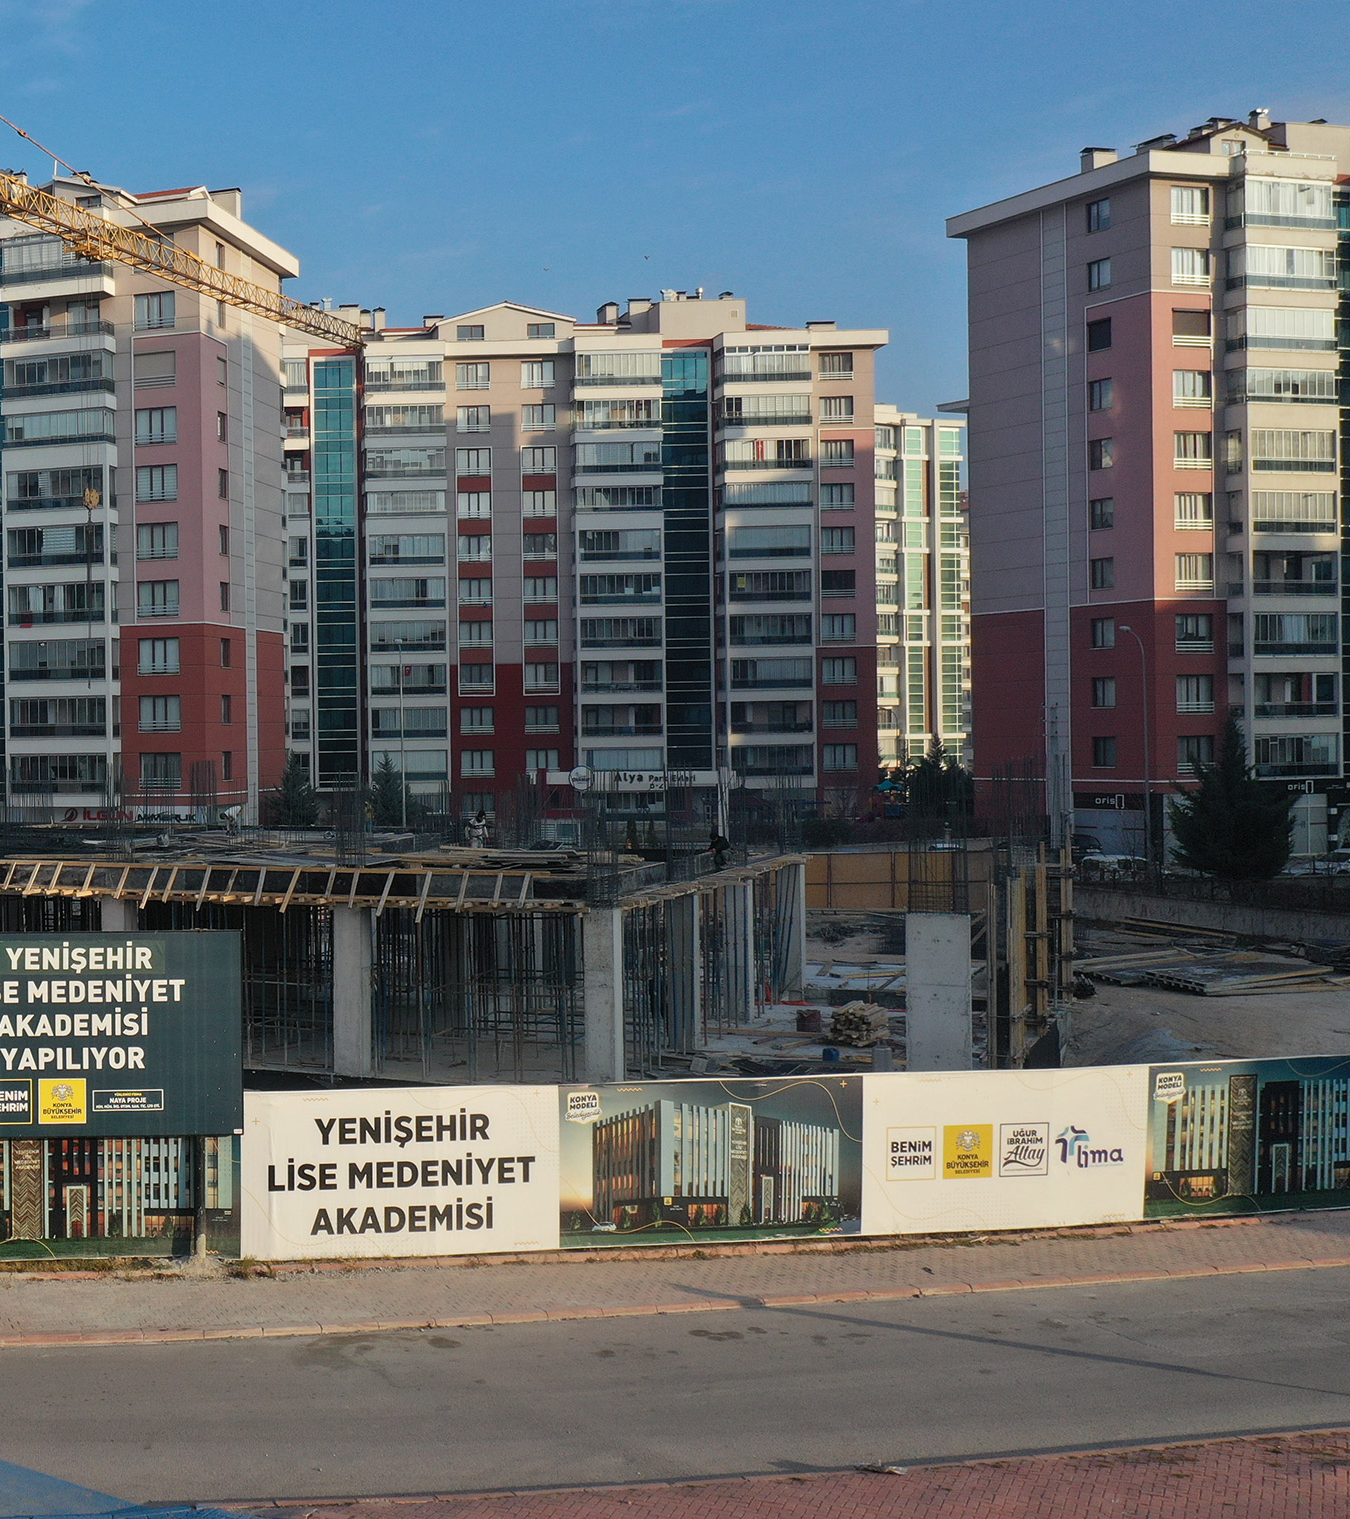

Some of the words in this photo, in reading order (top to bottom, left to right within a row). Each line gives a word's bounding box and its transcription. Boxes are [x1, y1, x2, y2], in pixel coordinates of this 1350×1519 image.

[5, 941, 153, 974] YENİŞEHİR
[27, 973, 186, 1004] MEDENİYET
[0, 1046, 146, 1071] YAPILIYOR
[1157, 1074, 1183, 1084] KONYA
[569, 1094, 597, 1104] KONYA
[314, 1108, 490, 1149] YENİŞEHİR
[1012, 1127, 1038, 1138] UĞUR
[1002, 1145, 1046, 1168] Altay
[267, 1157, 338, 1192] LİSE
[348, 1152, 536, 1190] MEDENİYET
[310, 1196, 494, 1236] AKADEMİSİ
